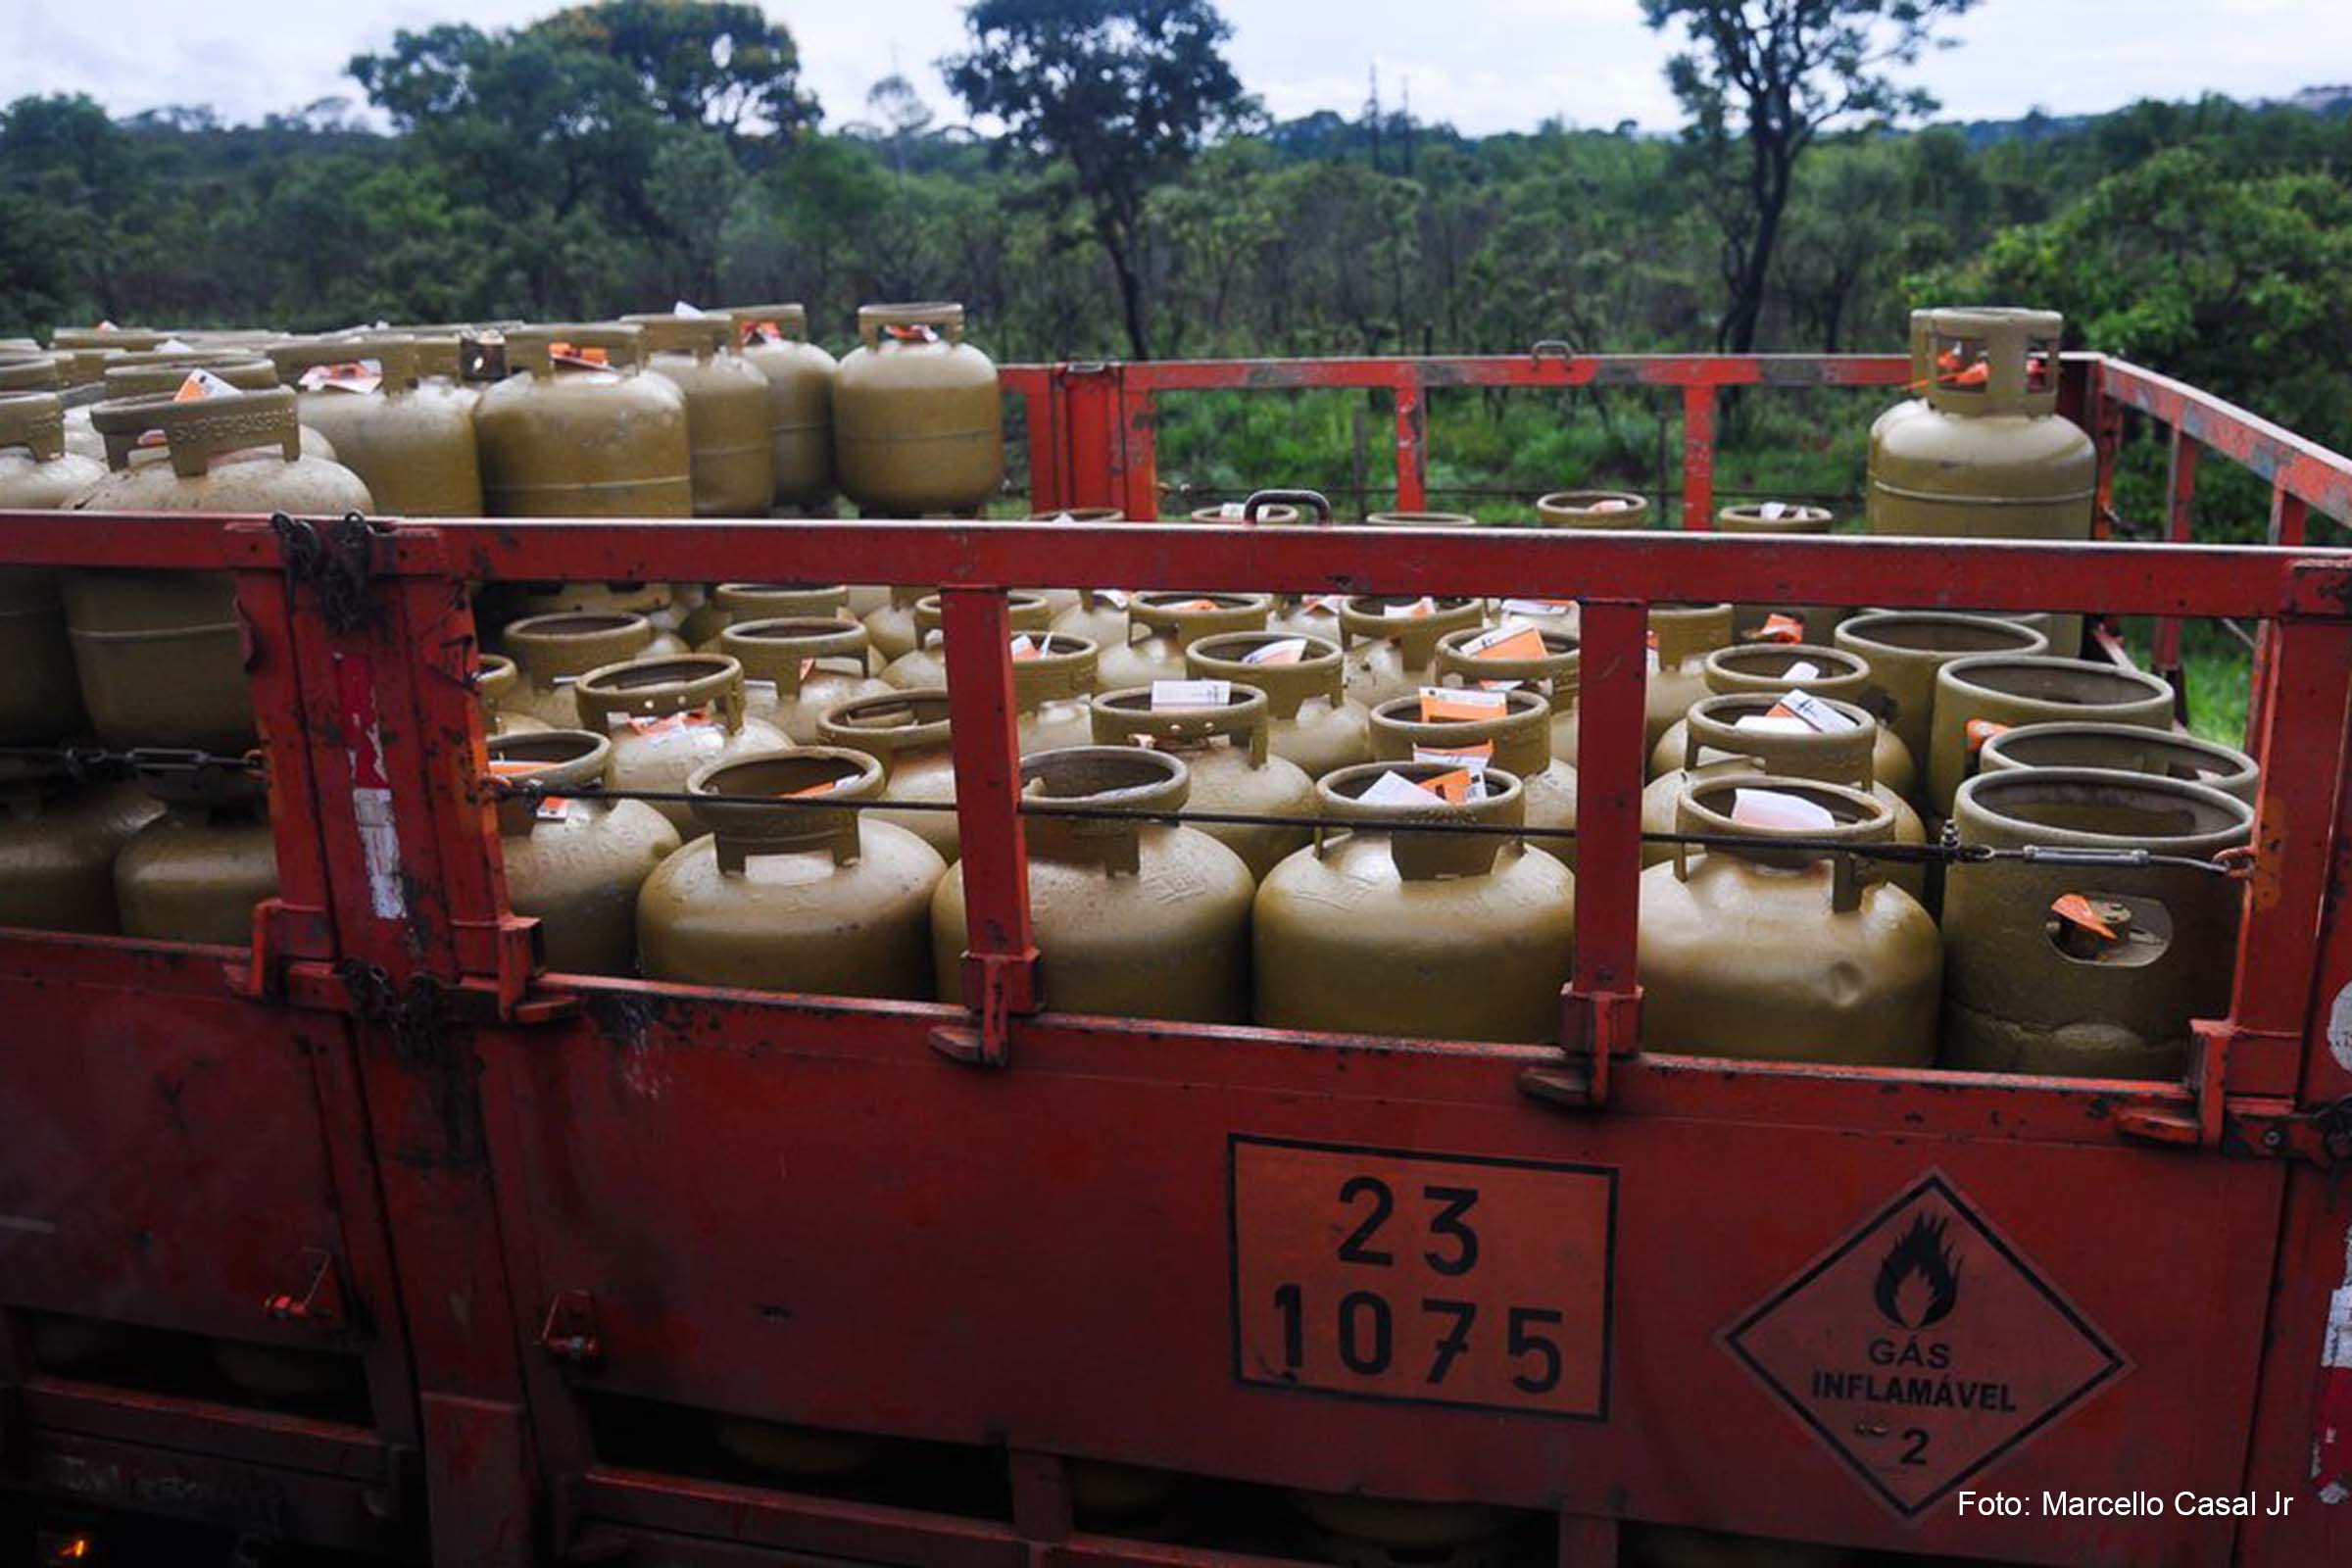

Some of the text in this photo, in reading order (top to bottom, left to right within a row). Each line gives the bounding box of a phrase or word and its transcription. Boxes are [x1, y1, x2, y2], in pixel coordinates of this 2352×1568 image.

[1339, 1177, 1479, 1276] 23
[1275, 1284, 1562, 1395] 1075
[1869, 1335, 1951, 1369] GÁS
[1813, 1374, 2017, 1412] INFLAMÁVEL
[1900, 1428, 1931, 1465] 2
